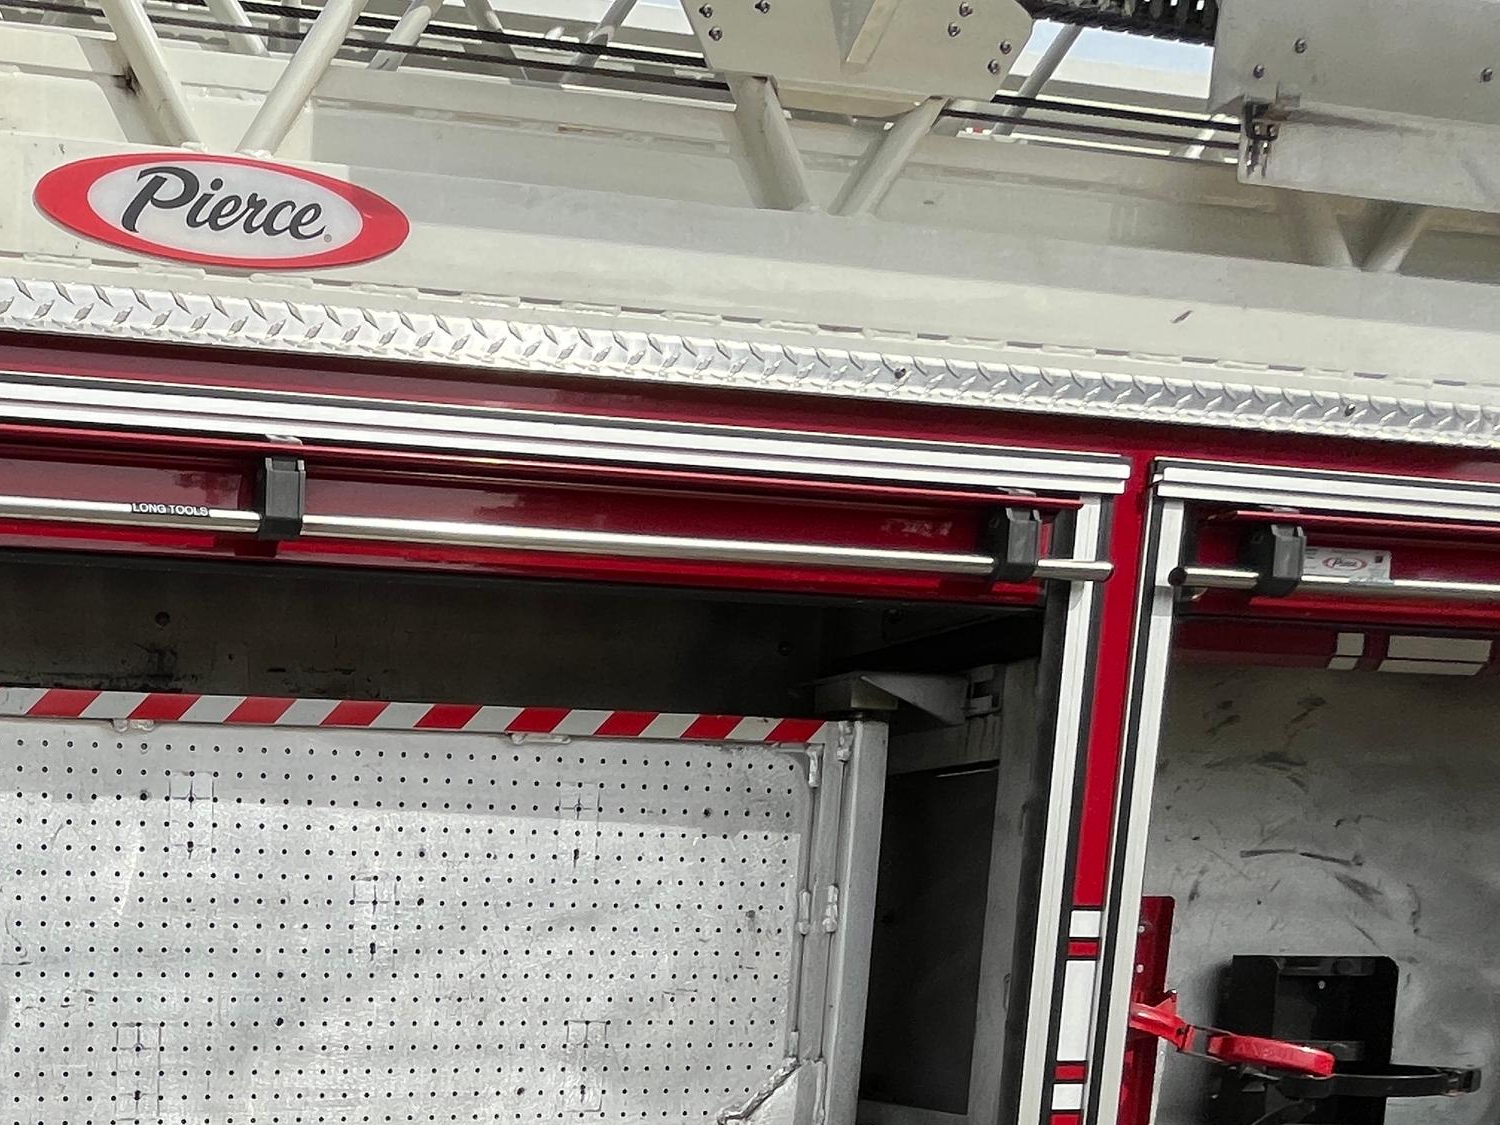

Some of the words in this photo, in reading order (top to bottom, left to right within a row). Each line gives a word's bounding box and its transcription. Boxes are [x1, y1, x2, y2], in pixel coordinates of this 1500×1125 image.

[121, 166, 326, 240] Pierce
[132, 503, 166, 513] LONG
[168, 505, 208, 516] TOOLS
